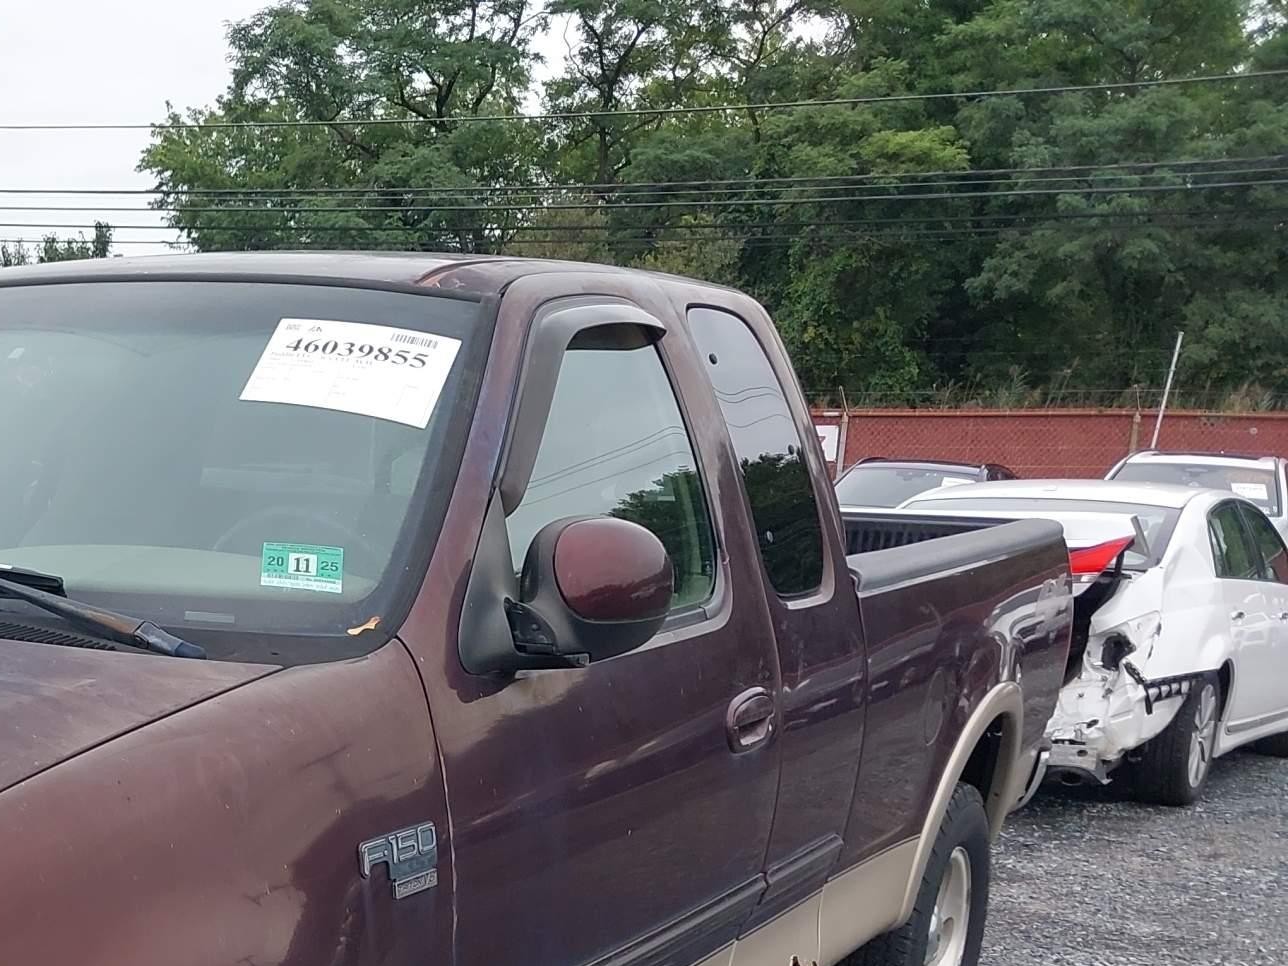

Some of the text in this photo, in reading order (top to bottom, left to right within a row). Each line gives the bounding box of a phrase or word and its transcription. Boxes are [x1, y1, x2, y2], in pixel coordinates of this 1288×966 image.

[285, 337, 430, 369] 46039855
[267, 555, 340, 574] 20 11 25
